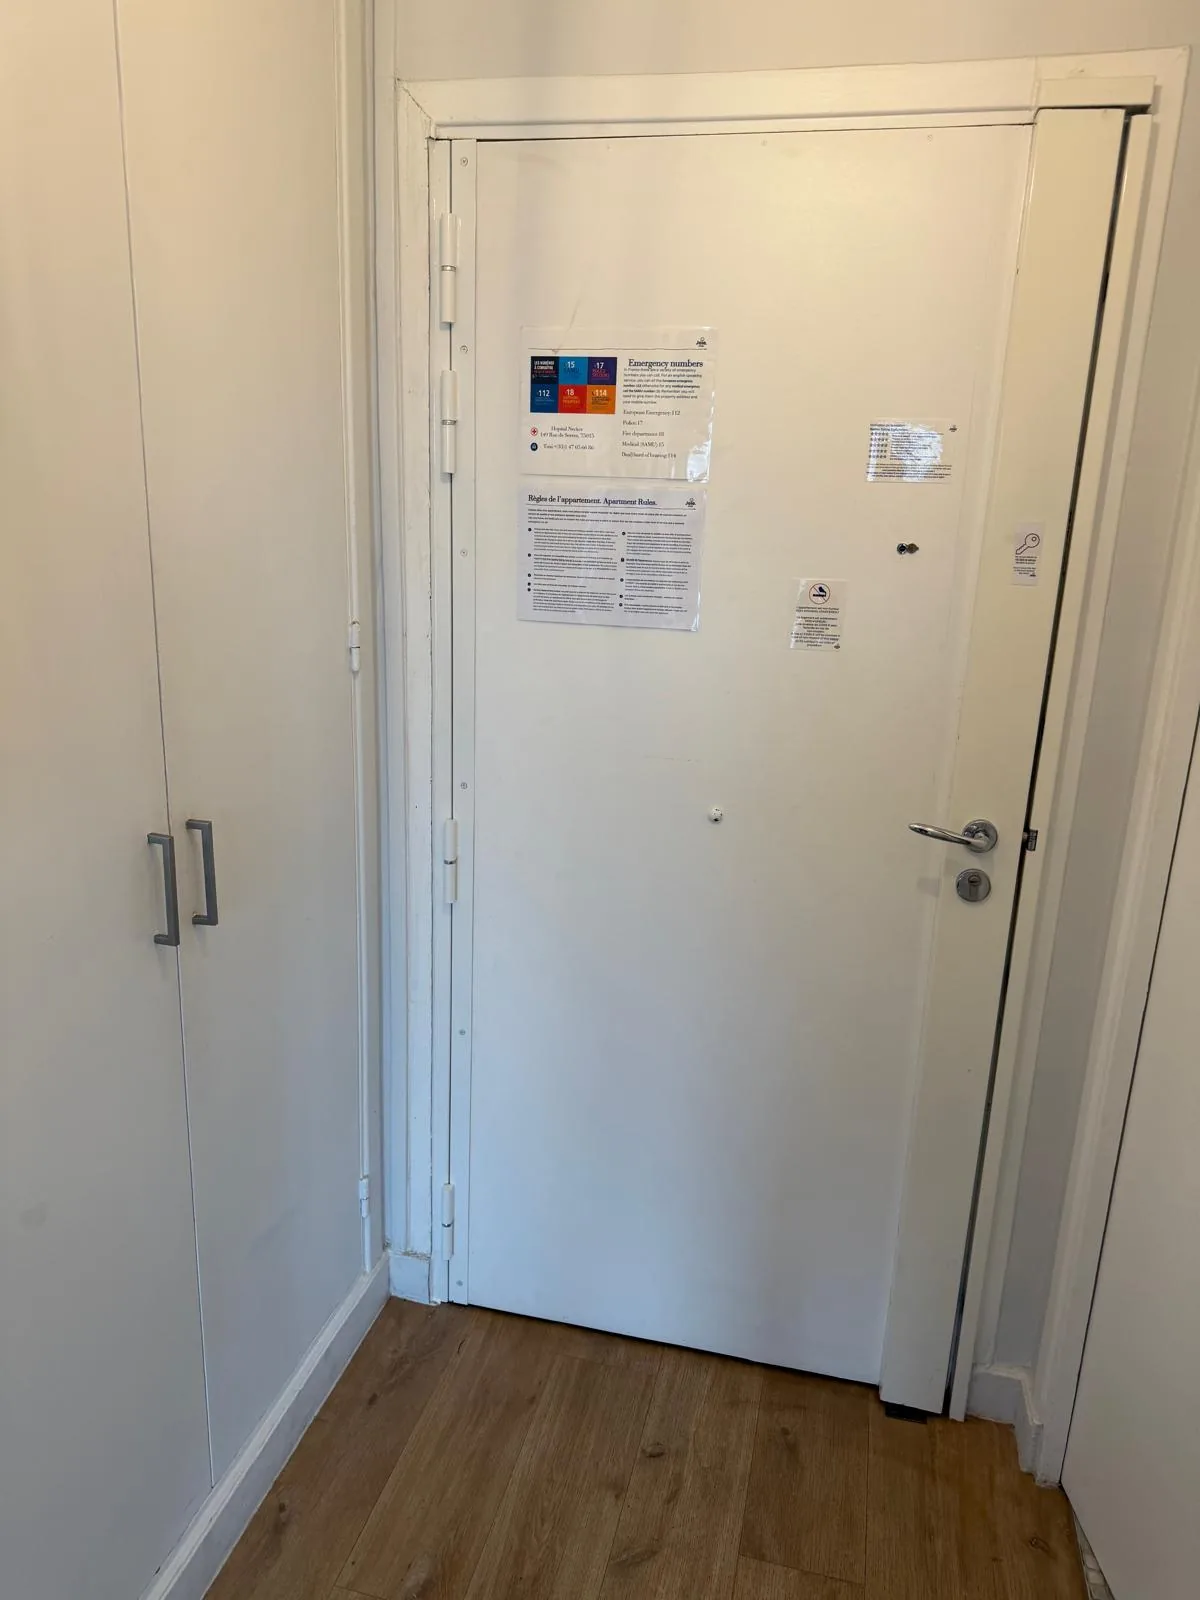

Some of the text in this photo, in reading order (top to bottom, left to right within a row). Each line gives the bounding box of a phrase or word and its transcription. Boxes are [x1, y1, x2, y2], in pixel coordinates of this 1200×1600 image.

[628, 359, 703, 369] Emergency numbers
[528, 495, 547, 503] Règles
[603, 498, 636, 506] Apartment
